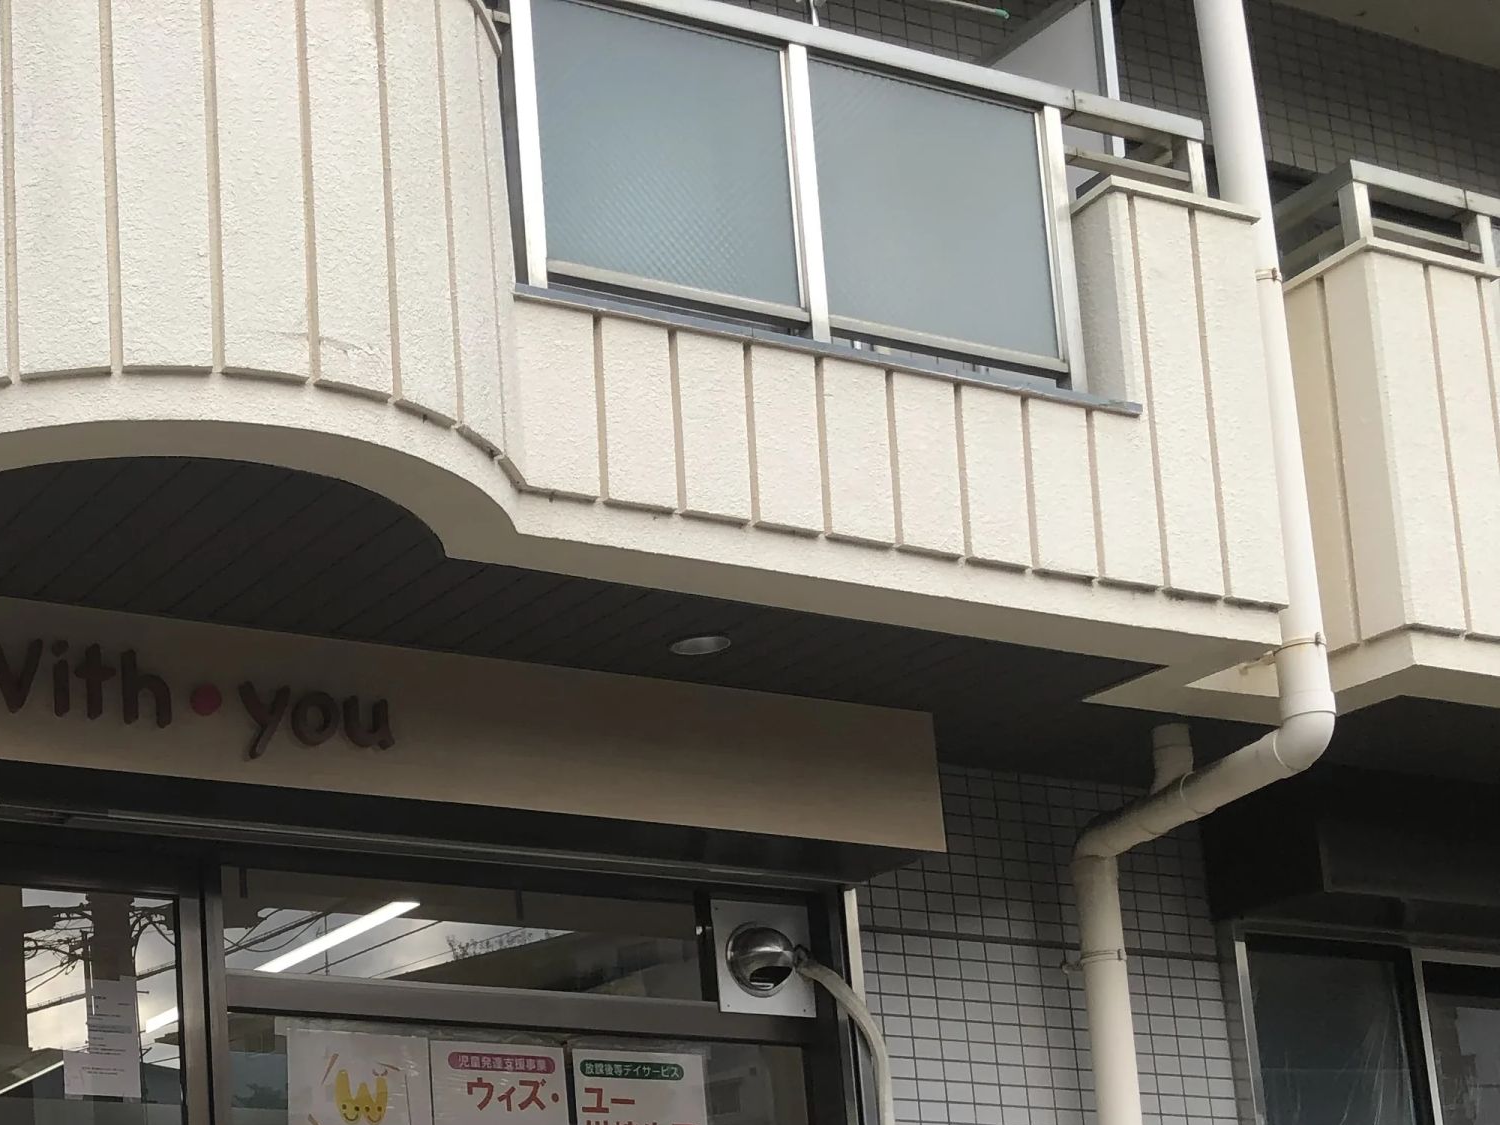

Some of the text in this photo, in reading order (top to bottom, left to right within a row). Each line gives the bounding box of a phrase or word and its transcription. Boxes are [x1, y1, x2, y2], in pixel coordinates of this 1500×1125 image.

[584, 1062, 681, 1079] 放課後等デイサービス
